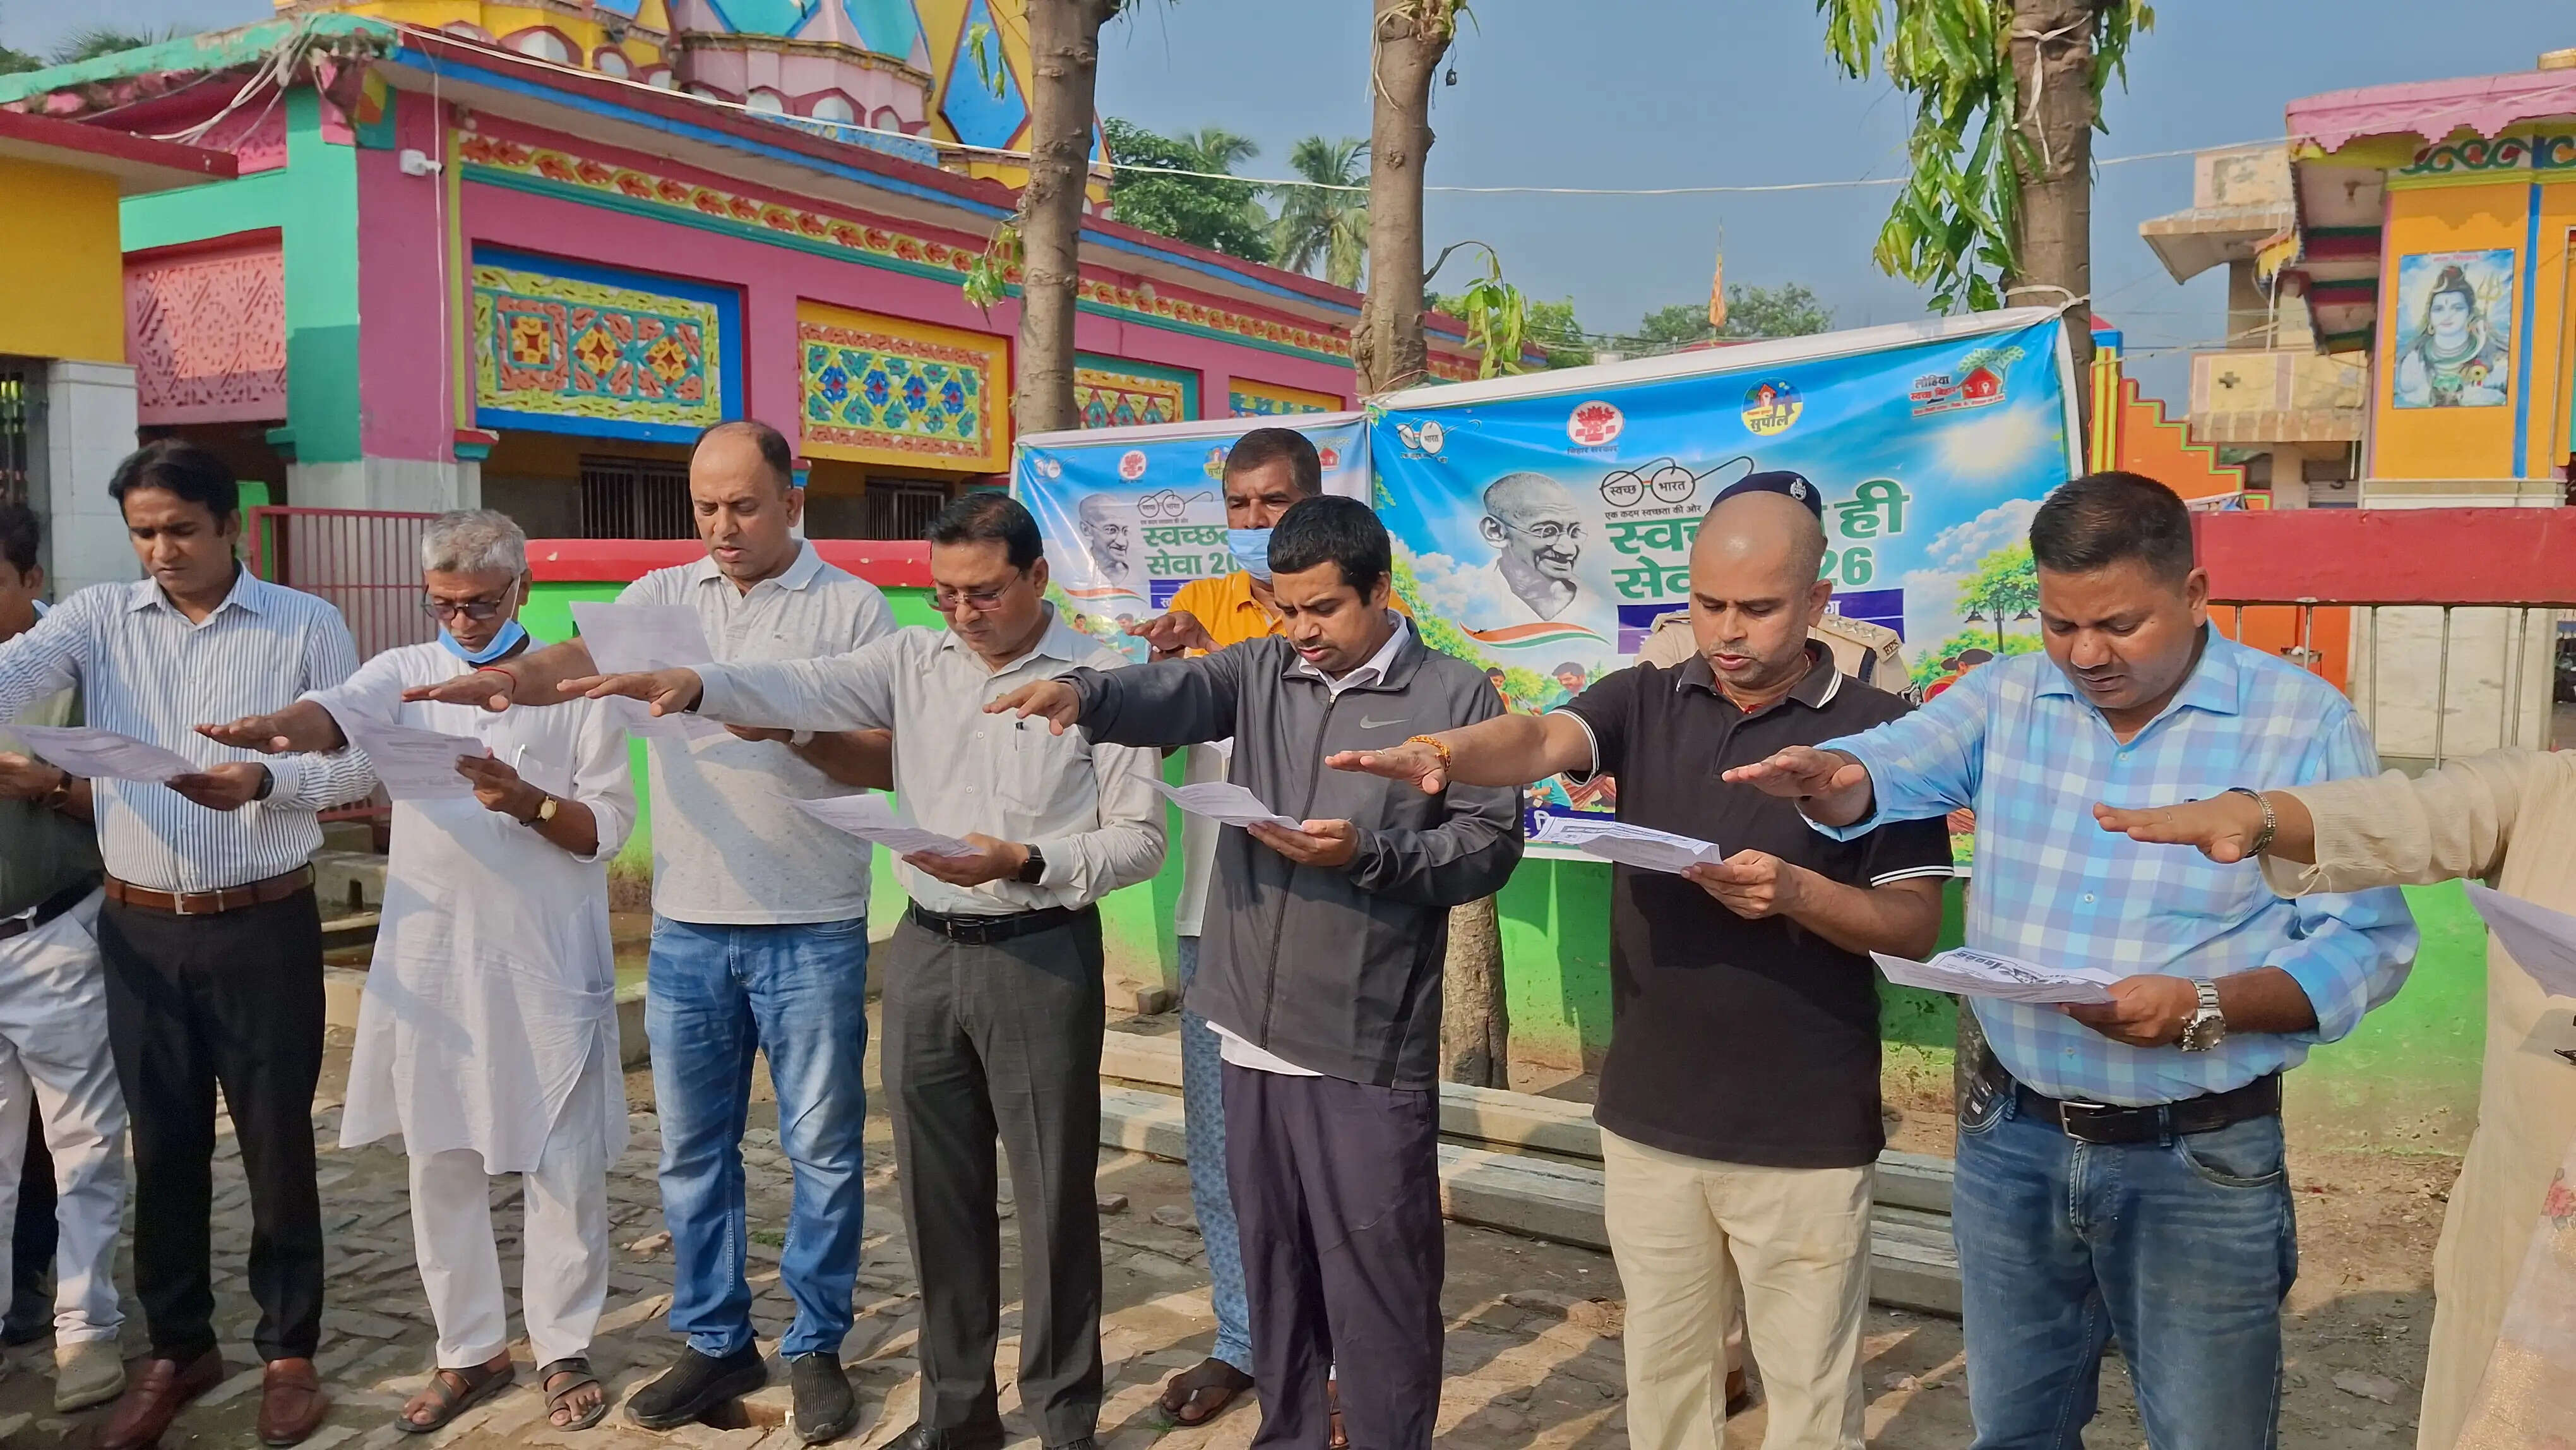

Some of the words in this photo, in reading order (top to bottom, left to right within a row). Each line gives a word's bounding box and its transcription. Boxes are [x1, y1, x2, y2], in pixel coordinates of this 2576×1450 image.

[1750, 414, 1789, 433] सुपौल
[1609, 484, 1637, 496] स्वच्छ
[1658, 480, 1686, 491] भारत
[1604, 510, 1618, 521] एक
[1620, 509, 1640, 519] कदम
[1642, 508, 1671, 517] स्वच्छता
[1673, 505, 1685, 514] की
[1686, 503, 1702, 513] ओर
[1834, 479, 1911, 539] ही
[1144, 548, 1202, 575] सेवा
[1208, 552, 1246, 575] 20
[1816, 547, 1873, 586] 26
